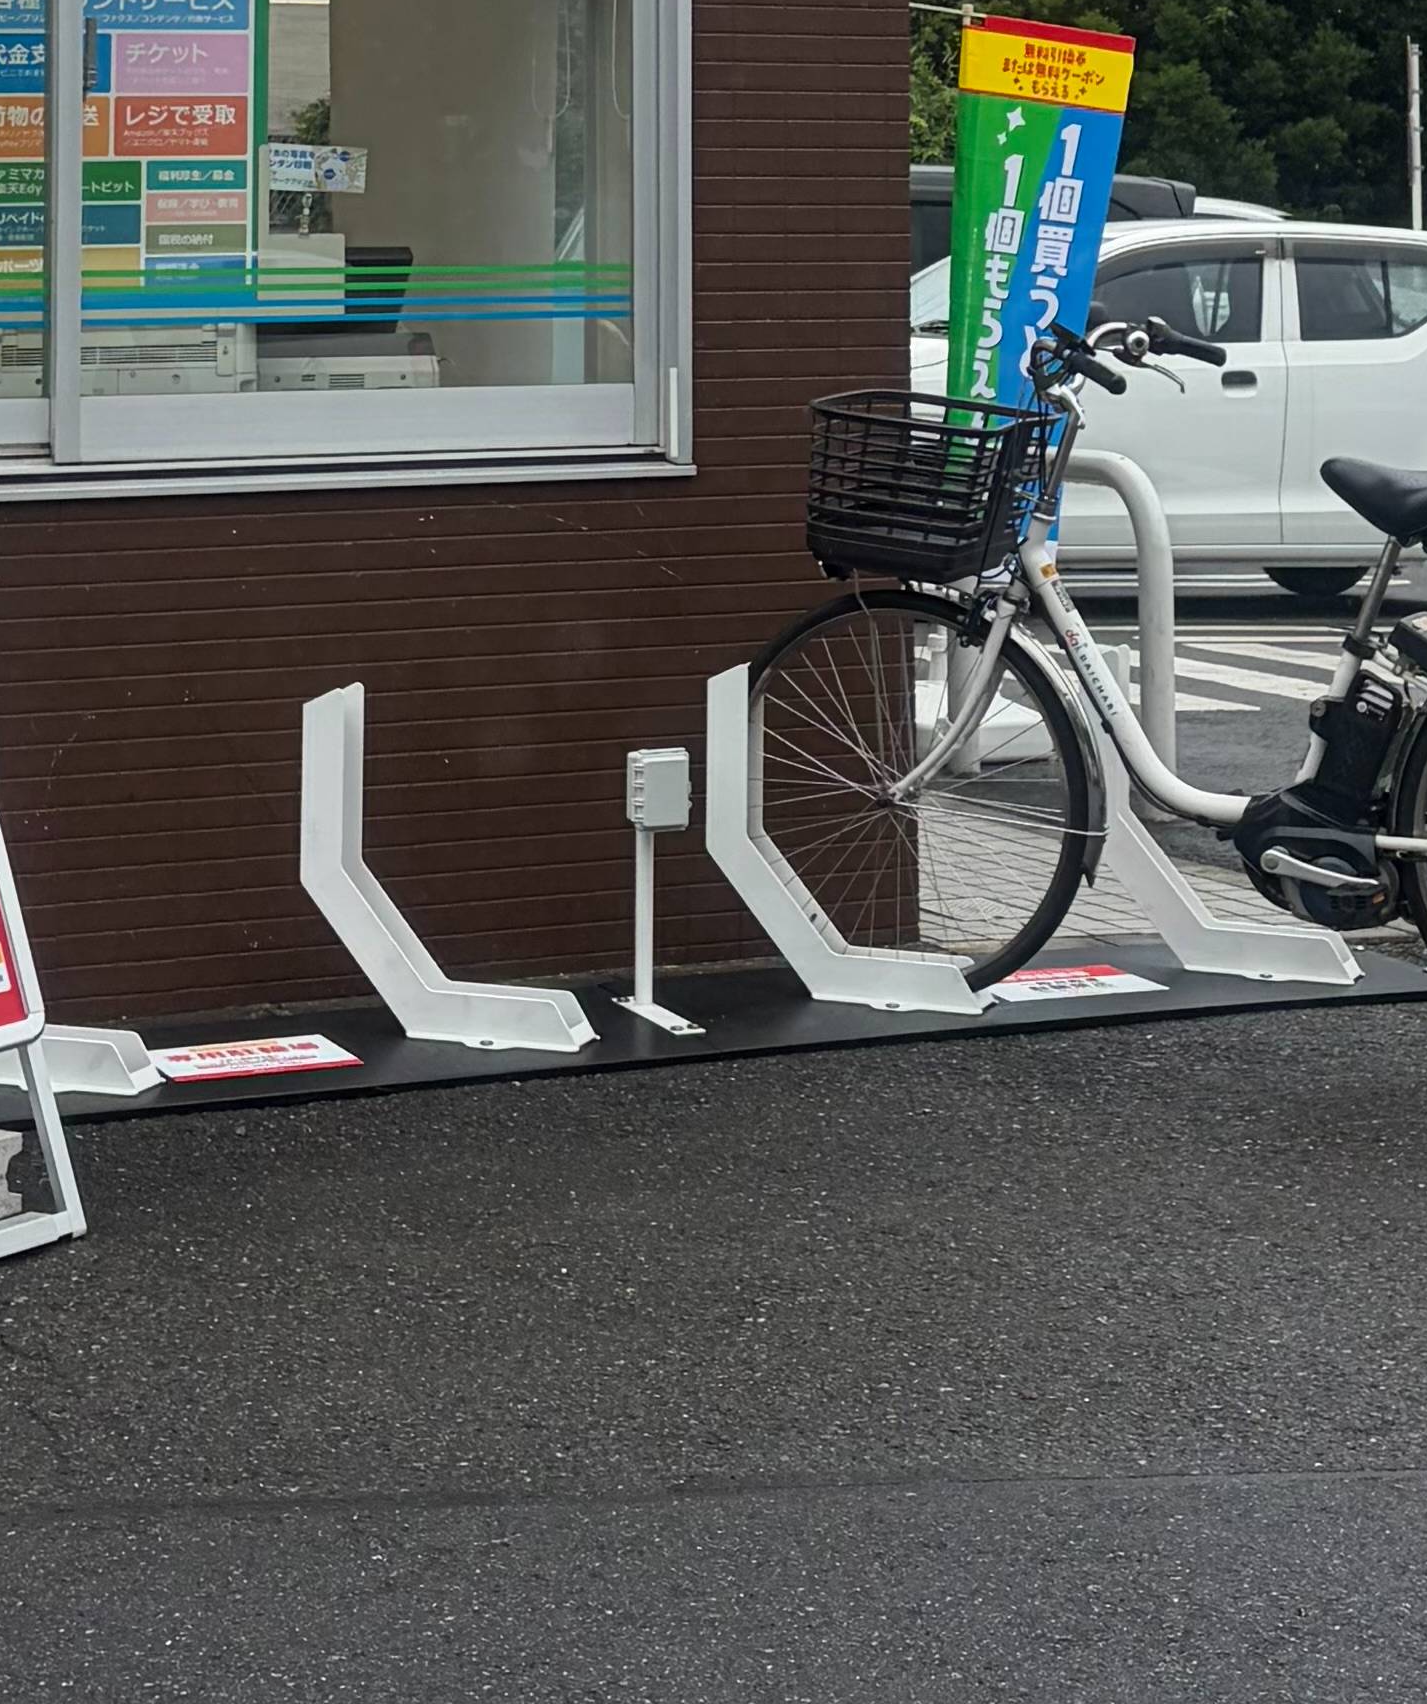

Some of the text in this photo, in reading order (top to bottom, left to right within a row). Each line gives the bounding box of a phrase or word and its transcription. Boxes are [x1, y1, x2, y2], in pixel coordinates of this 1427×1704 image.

[126, 43, 209, 64] チケット
[1031, 80, 1070, 99] もらえる
[126, 104, 236, 126] レジで受取
